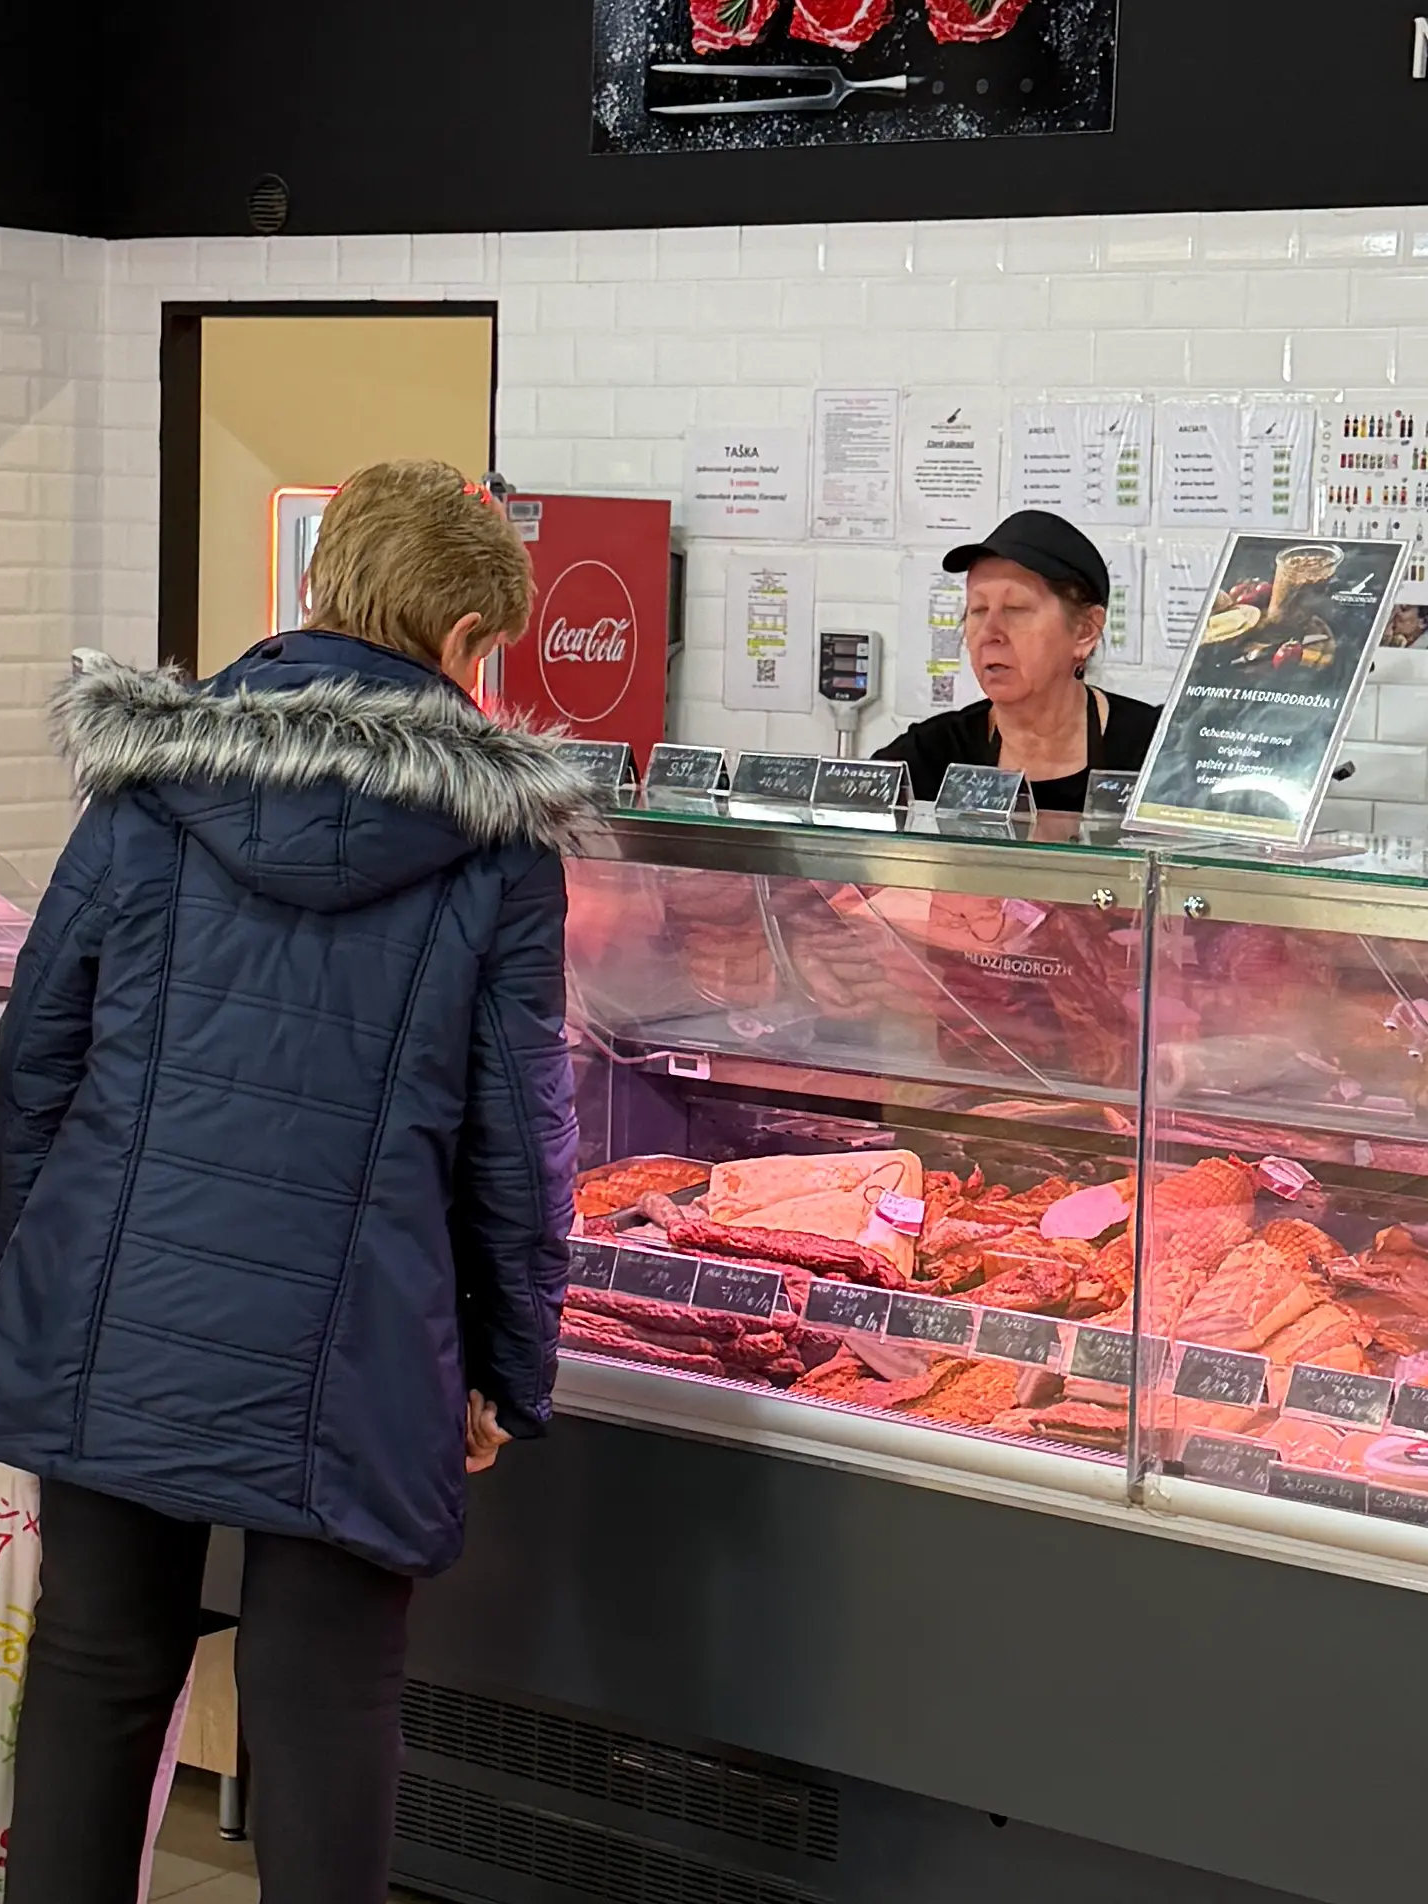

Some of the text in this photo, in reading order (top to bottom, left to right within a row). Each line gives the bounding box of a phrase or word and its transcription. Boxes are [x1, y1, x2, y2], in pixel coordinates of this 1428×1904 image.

[724, 444, 759, 458] TAŠKA
[544, 617, 632, 663] Coca-Cola
[1186, 685, 1232, 699] NOVINKY
[1232, 688, 1241, 700] Z
